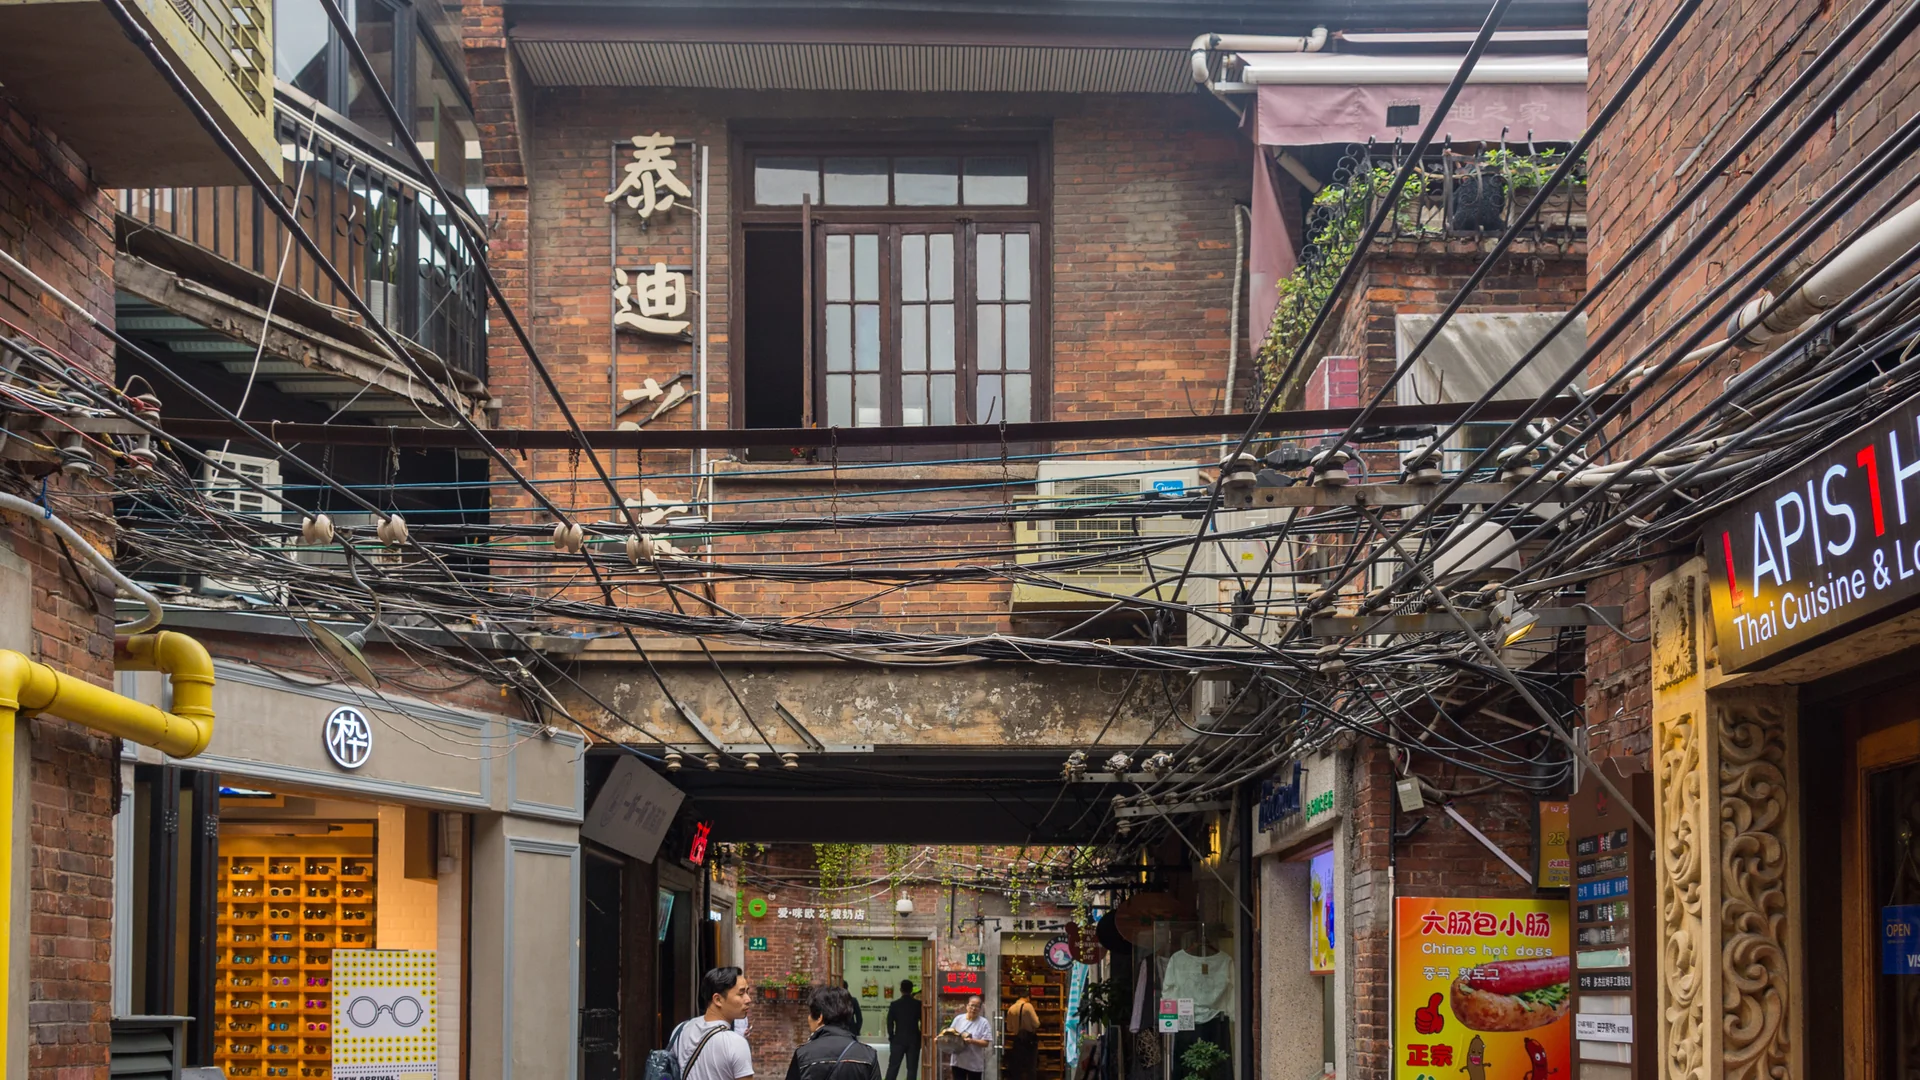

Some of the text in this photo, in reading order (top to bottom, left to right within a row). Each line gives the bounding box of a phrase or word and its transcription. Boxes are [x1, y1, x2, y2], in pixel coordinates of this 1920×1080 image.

[1733, 601, 1778, 651] Thai
[1781, 568, 1866, 630] Cuisine
[1873, 548, 1891, 590] &
[1421, 909, 1551, 937] 大肠包小肠
[1886, 924, 1911, 937] OPEN
[753, 938, 763, 946] 34
[1421, 943, 1553, 957] China's hot dogs
[1422, 966, 1500, 981] 중국 핫도그
[1406, 1044, 1453, 1067] 正宗
